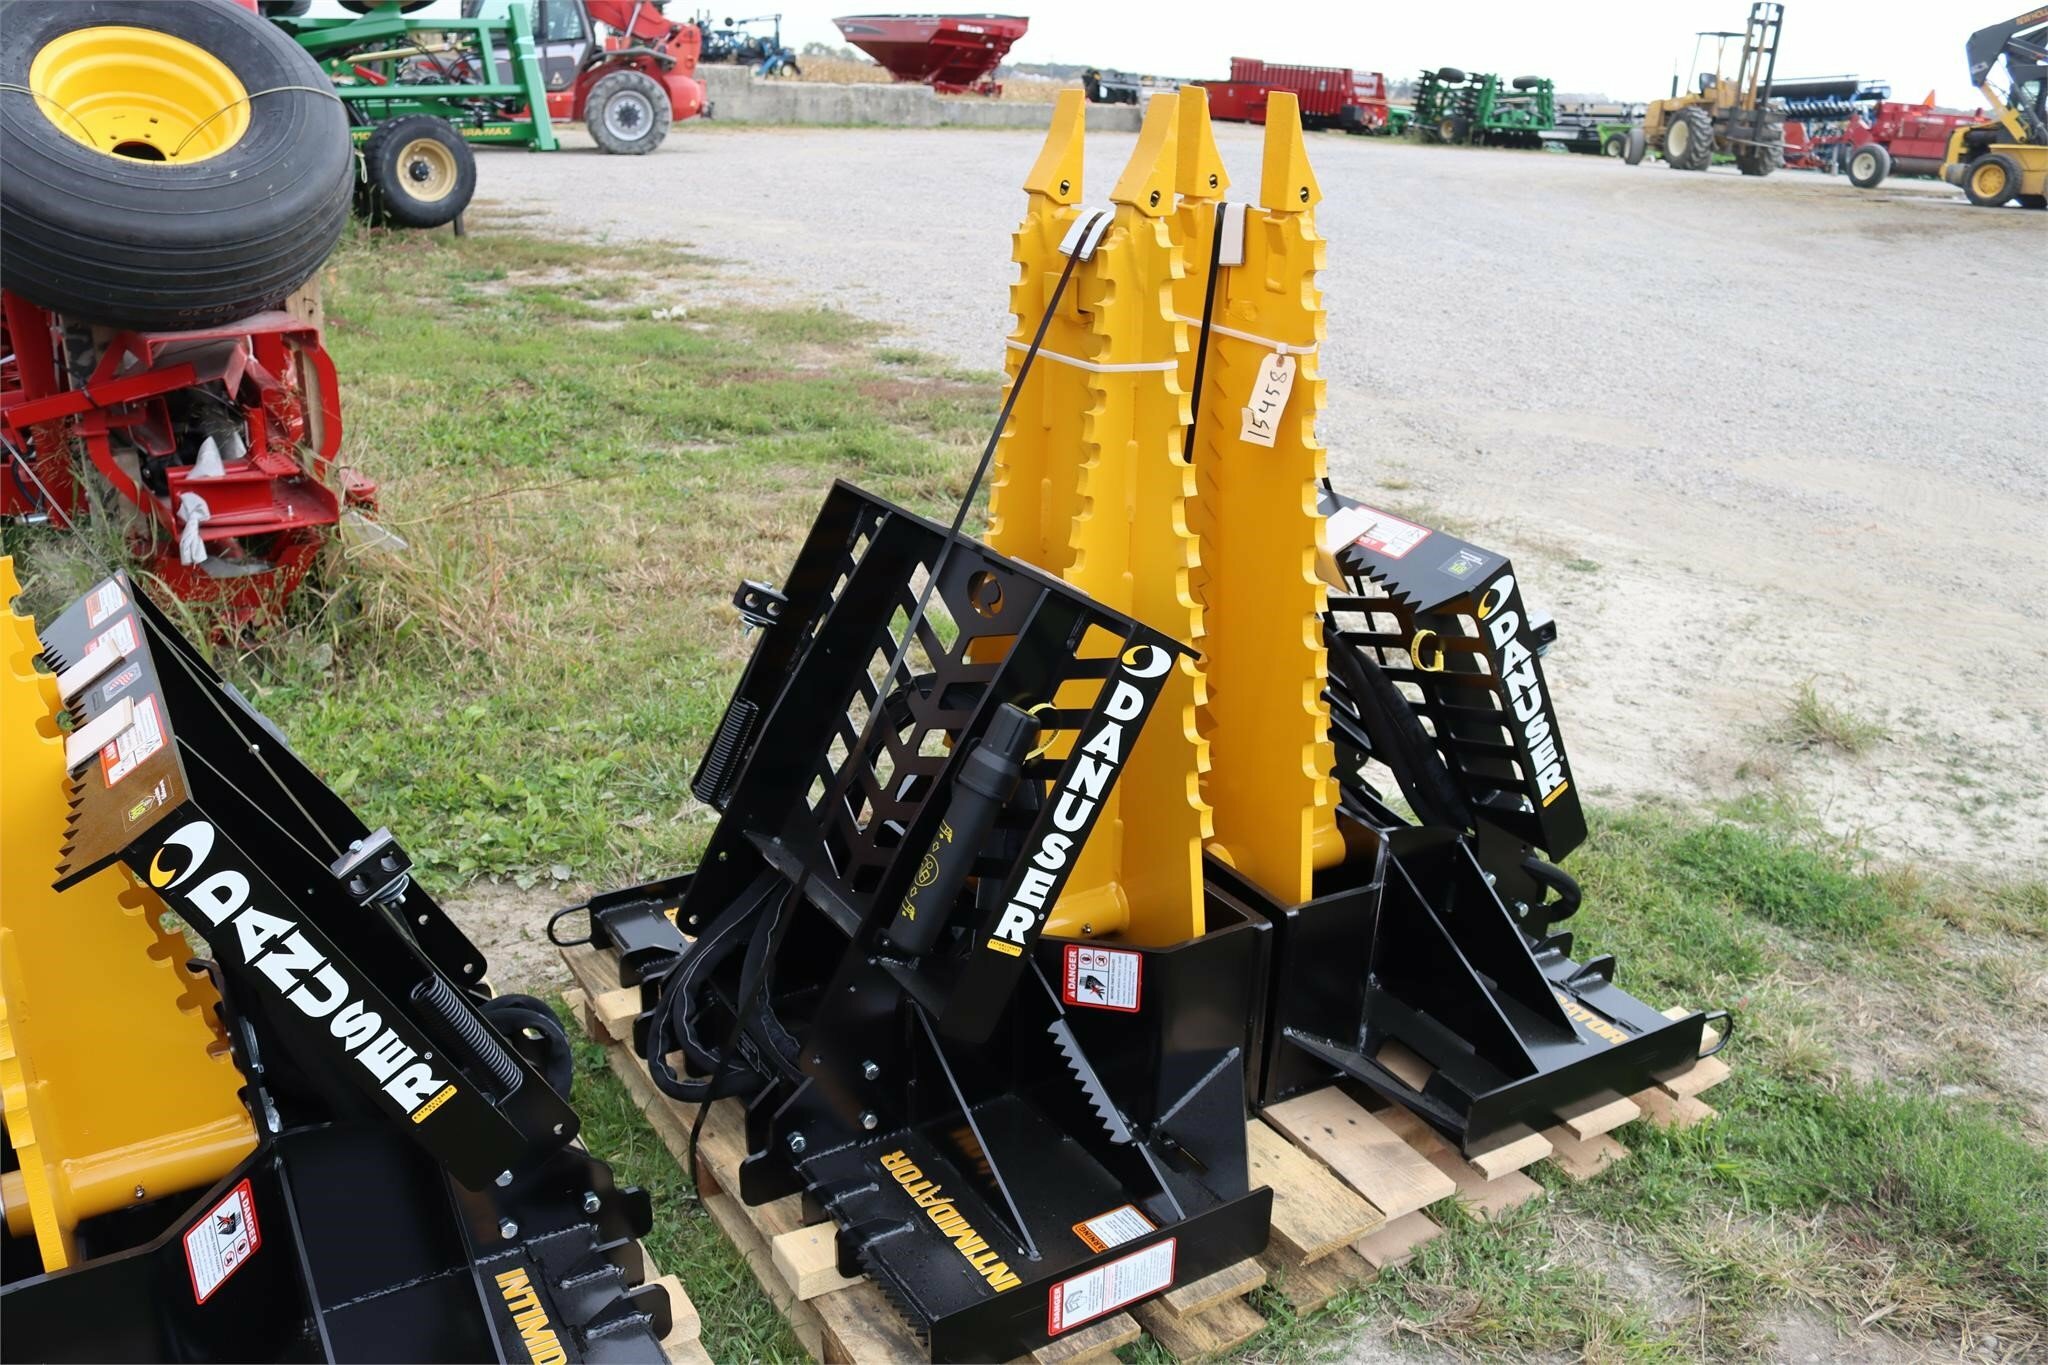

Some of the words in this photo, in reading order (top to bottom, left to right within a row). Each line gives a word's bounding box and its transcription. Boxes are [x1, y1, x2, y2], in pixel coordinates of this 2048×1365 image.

[1247, 370, 1288, 439] 15458
[1488, 610, 1567, 800] DANUSER
[993, 679, 1145, 945] DANUSER
[184, 870, 449, 1115] DANUSER
[1068, 951, 1077, 990] DANGER
[241, 1200, 257, 1247] DANGER
[879, 1150, 1023, 1293] INTIMIDATOR
[1077, 1225, 1106, 1250] ARNING
[1053, 1286, 1063, 1323] DANGER
